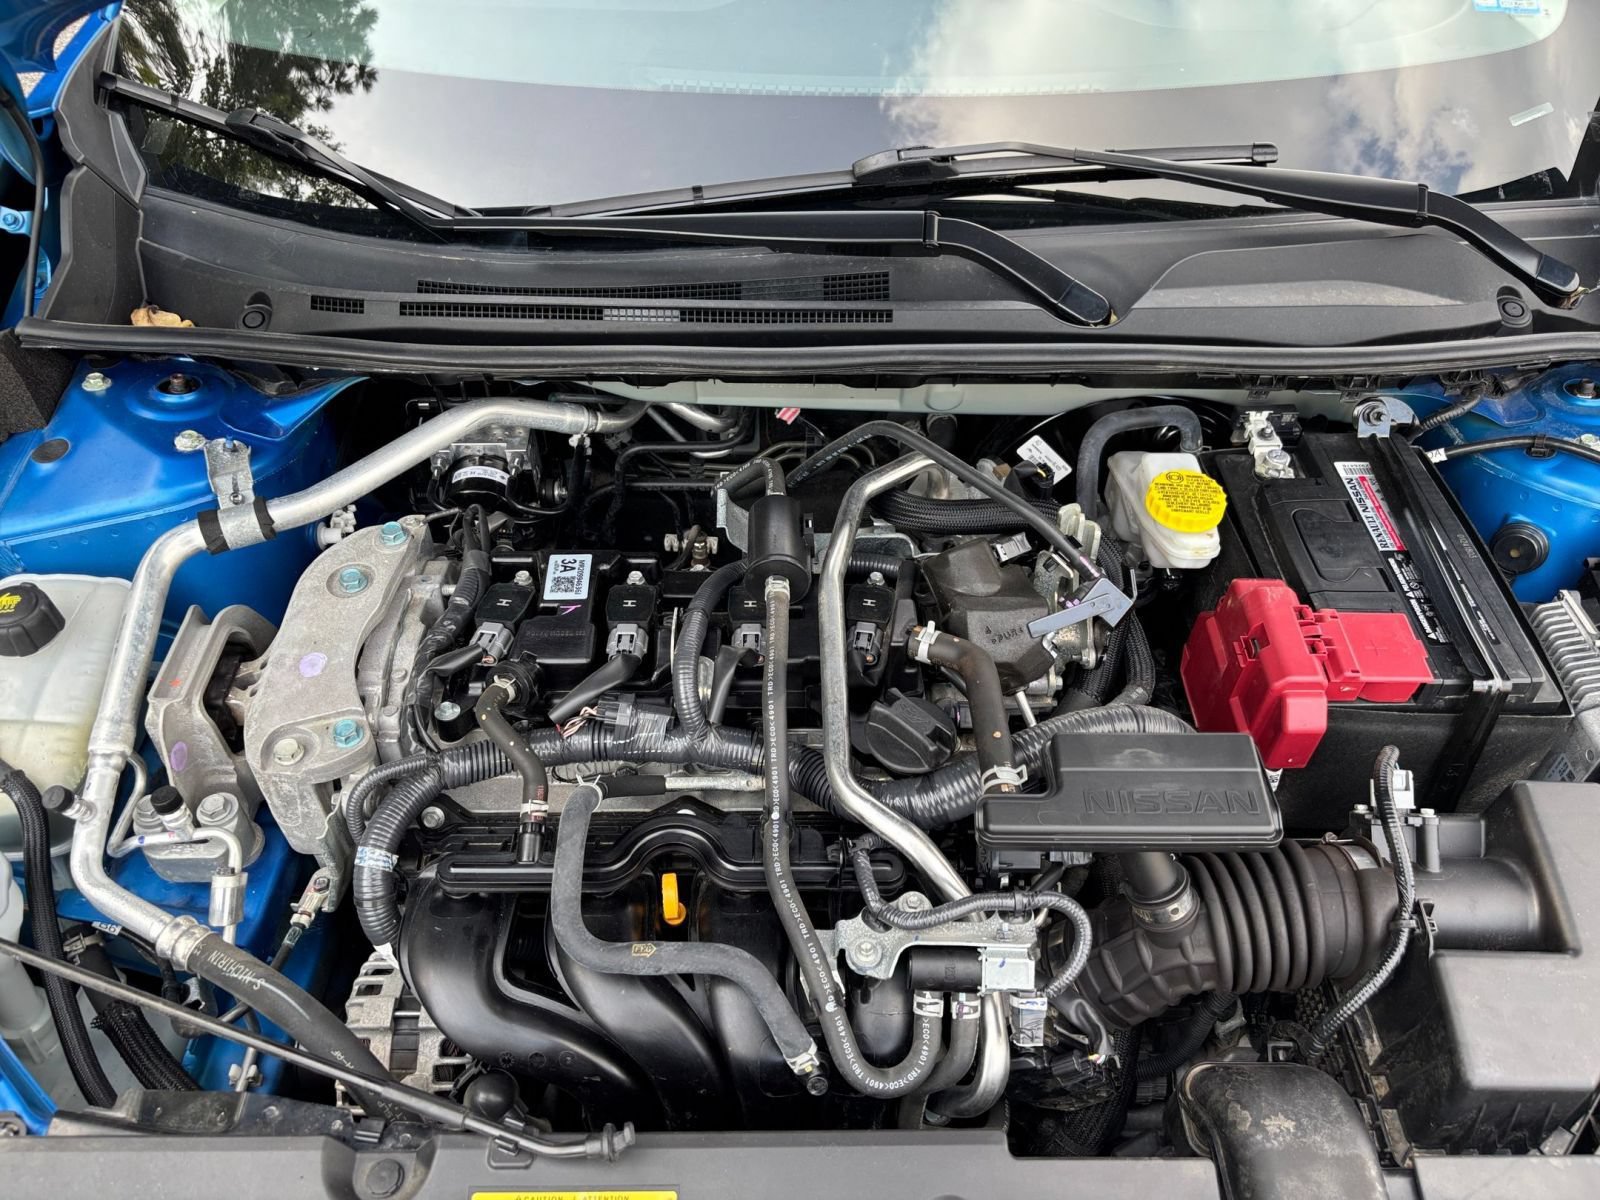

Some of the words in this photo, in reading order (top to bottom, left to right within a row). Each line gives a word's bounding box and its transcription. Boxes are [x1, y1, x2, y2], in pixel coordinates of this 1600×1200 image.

[1345, 477, 1371, 514] NISSAN
[1365, 514, 1390, 550] RENAULT
[560, 558, 577, 573] 3A
[1082, 788, 1261, 815] NISSAN
[207, 950, 256, 984] NICHIRIN
